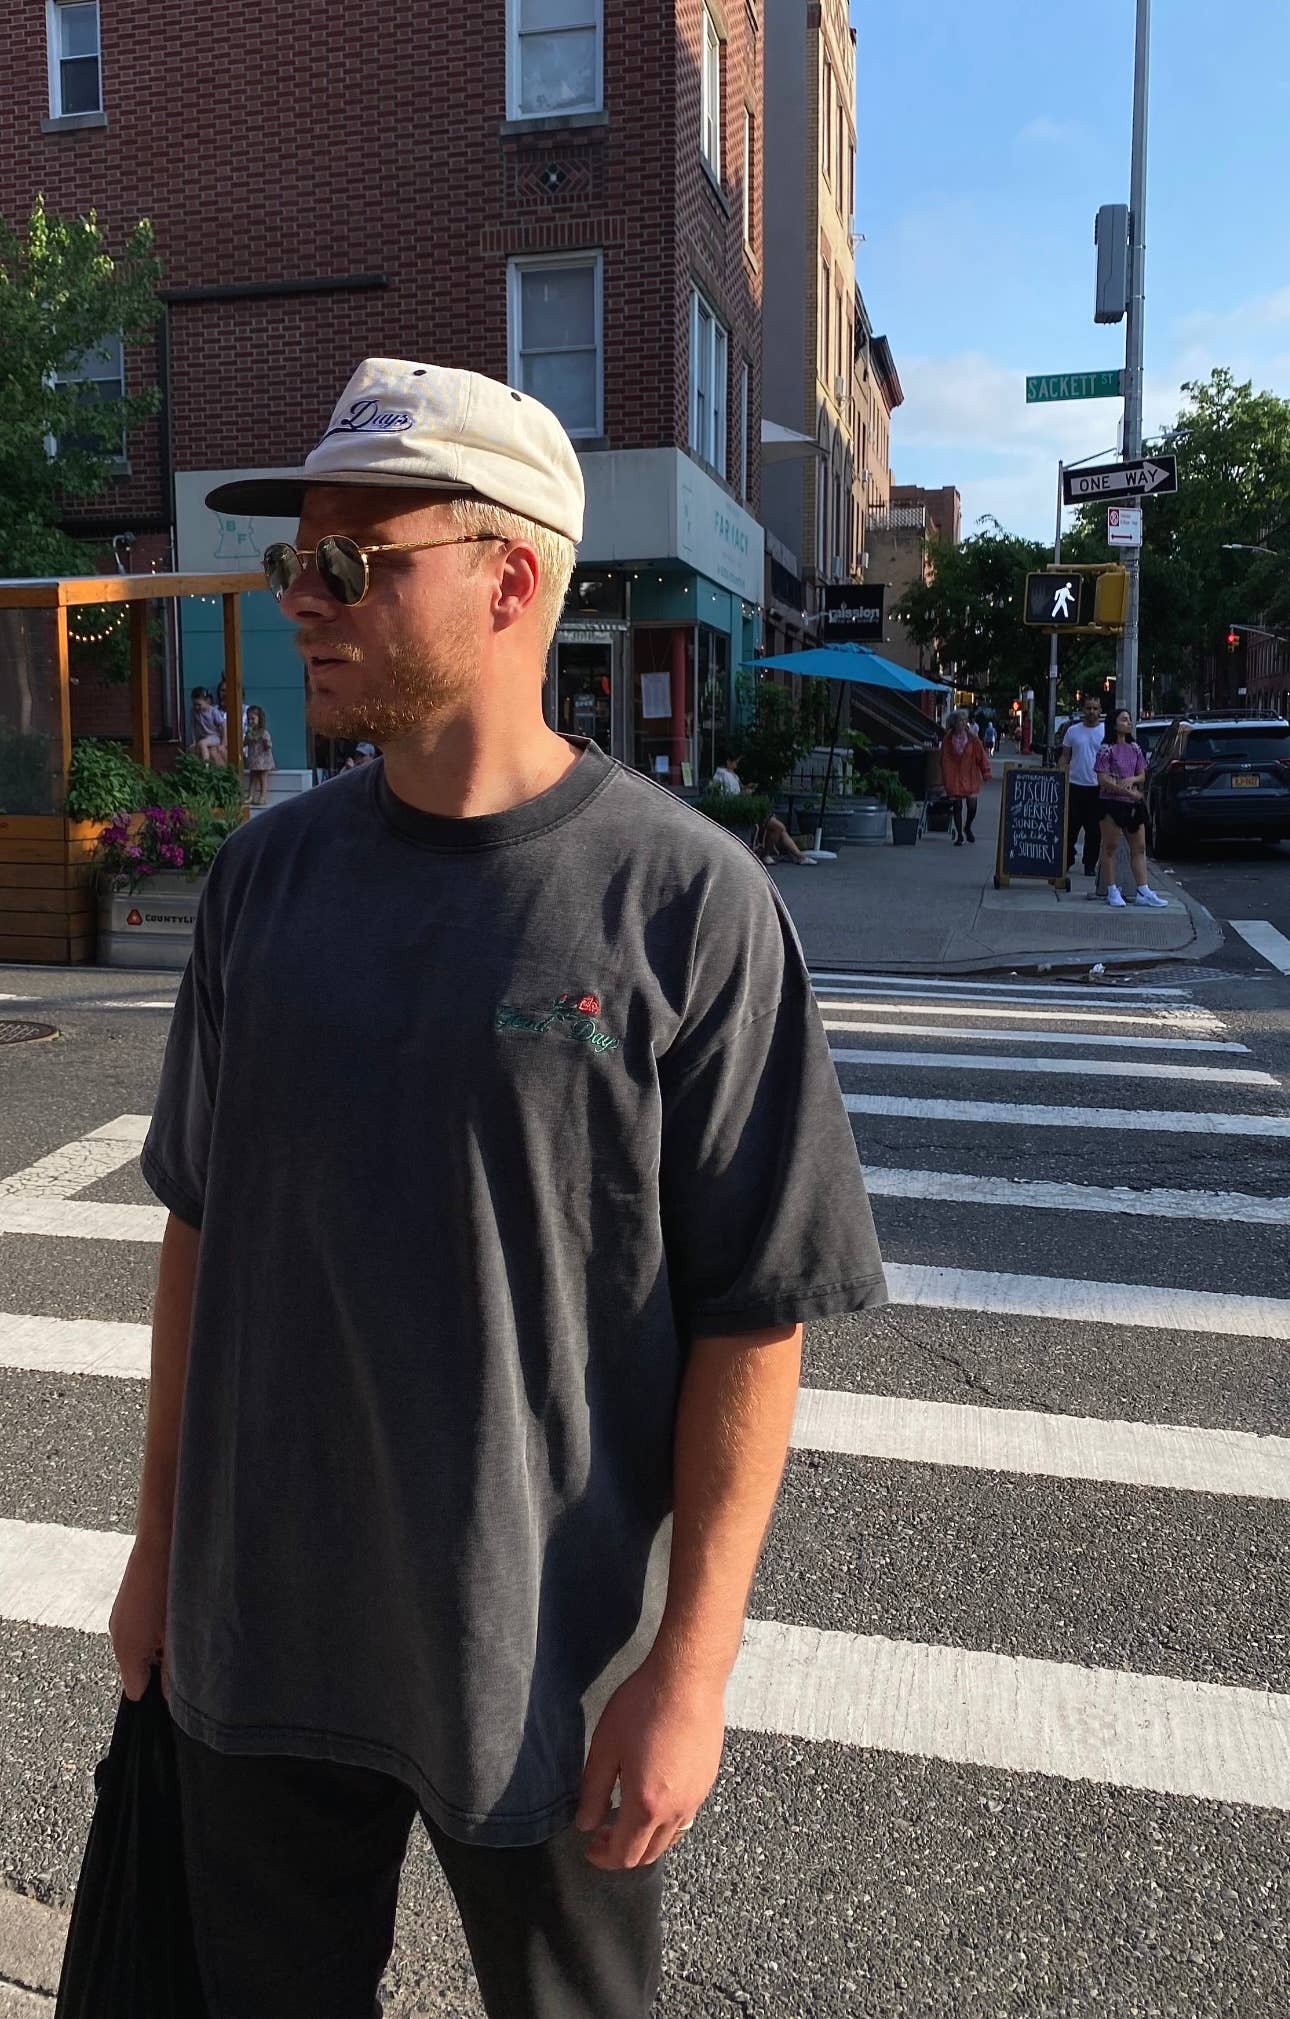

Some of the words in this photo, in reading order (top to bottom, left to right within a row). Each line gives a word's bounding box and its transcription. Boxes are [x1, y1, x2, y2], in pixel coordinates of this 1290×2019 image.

[1027, 374, 1097, 400] SACKETT
[1101, 373, 1114, 385] ST
[341, 400, 409, 430] Days
[1079, 475, 1111, 492] ONE
[1125, 468, 1158, 486] WAY
[226, 520, 236, 532] B
[237, 533, 248, 544] F
[1014, 780, 1059, 803] BISCUITS
[1023, 803, 1059, 823] BERRIES
[1011, 818, 1054, 833] SUNDAE
[1018, 840, 1055, 864] SUMMER!
[145, 914, 194, 924] COUNTYLI
